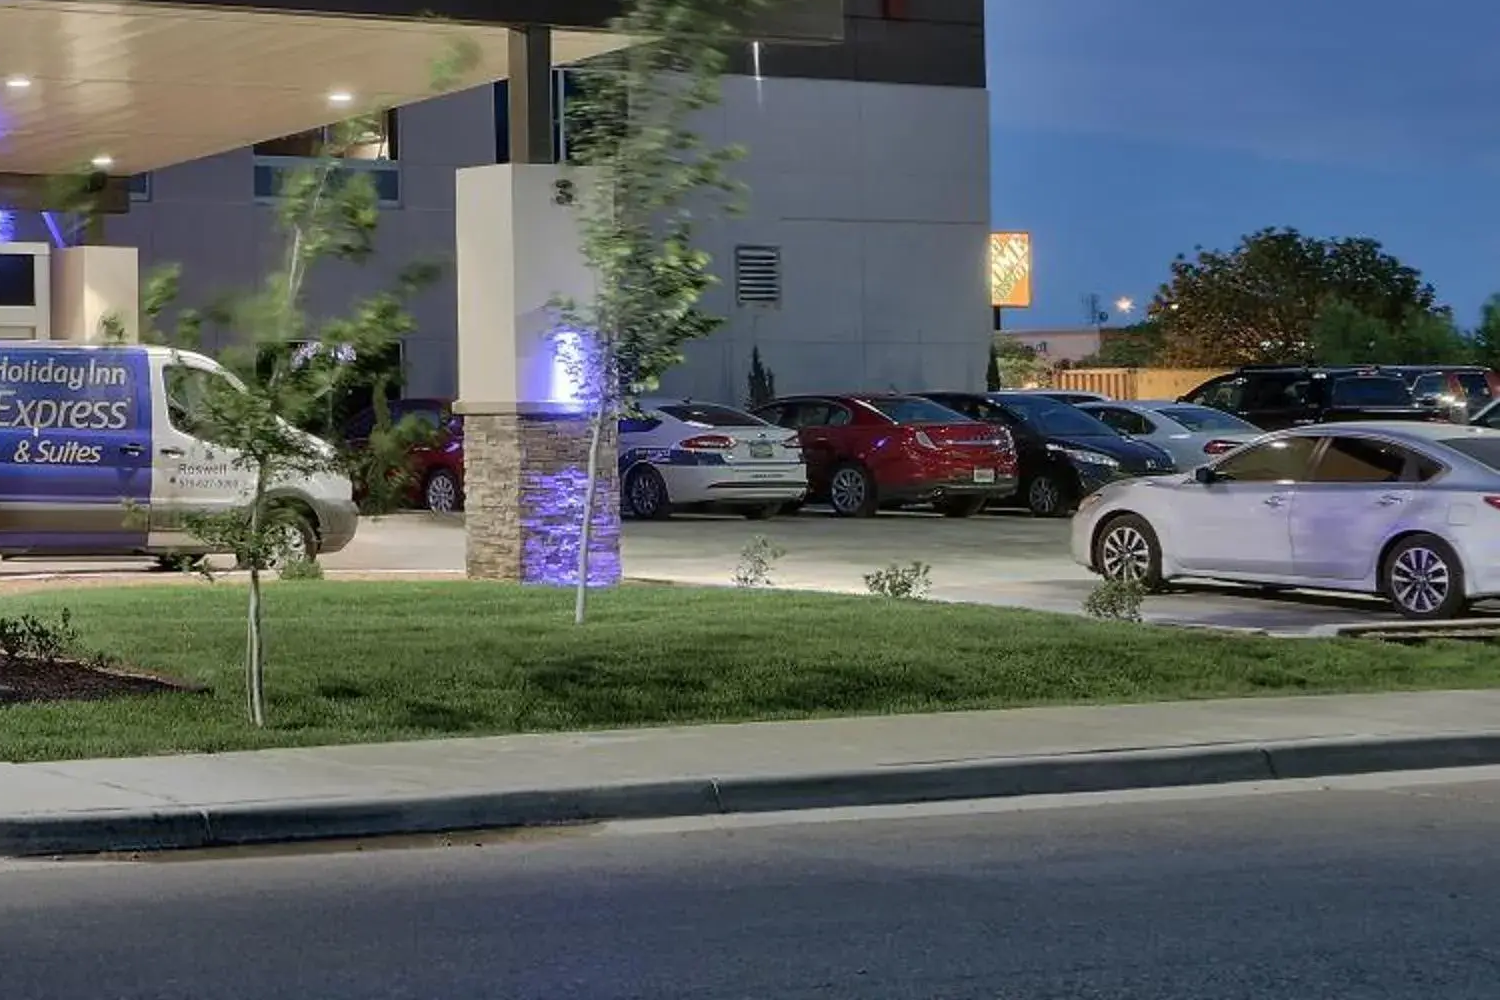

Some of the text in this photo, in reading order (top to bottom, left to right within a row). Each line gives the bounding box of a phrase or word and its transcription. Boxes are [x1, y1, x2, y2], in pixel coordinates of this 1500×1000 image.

[89, 358, 126, 385] Inn
[13, 439, 102, 463] & Suites
[179, 463, 228, 476] Roswell
